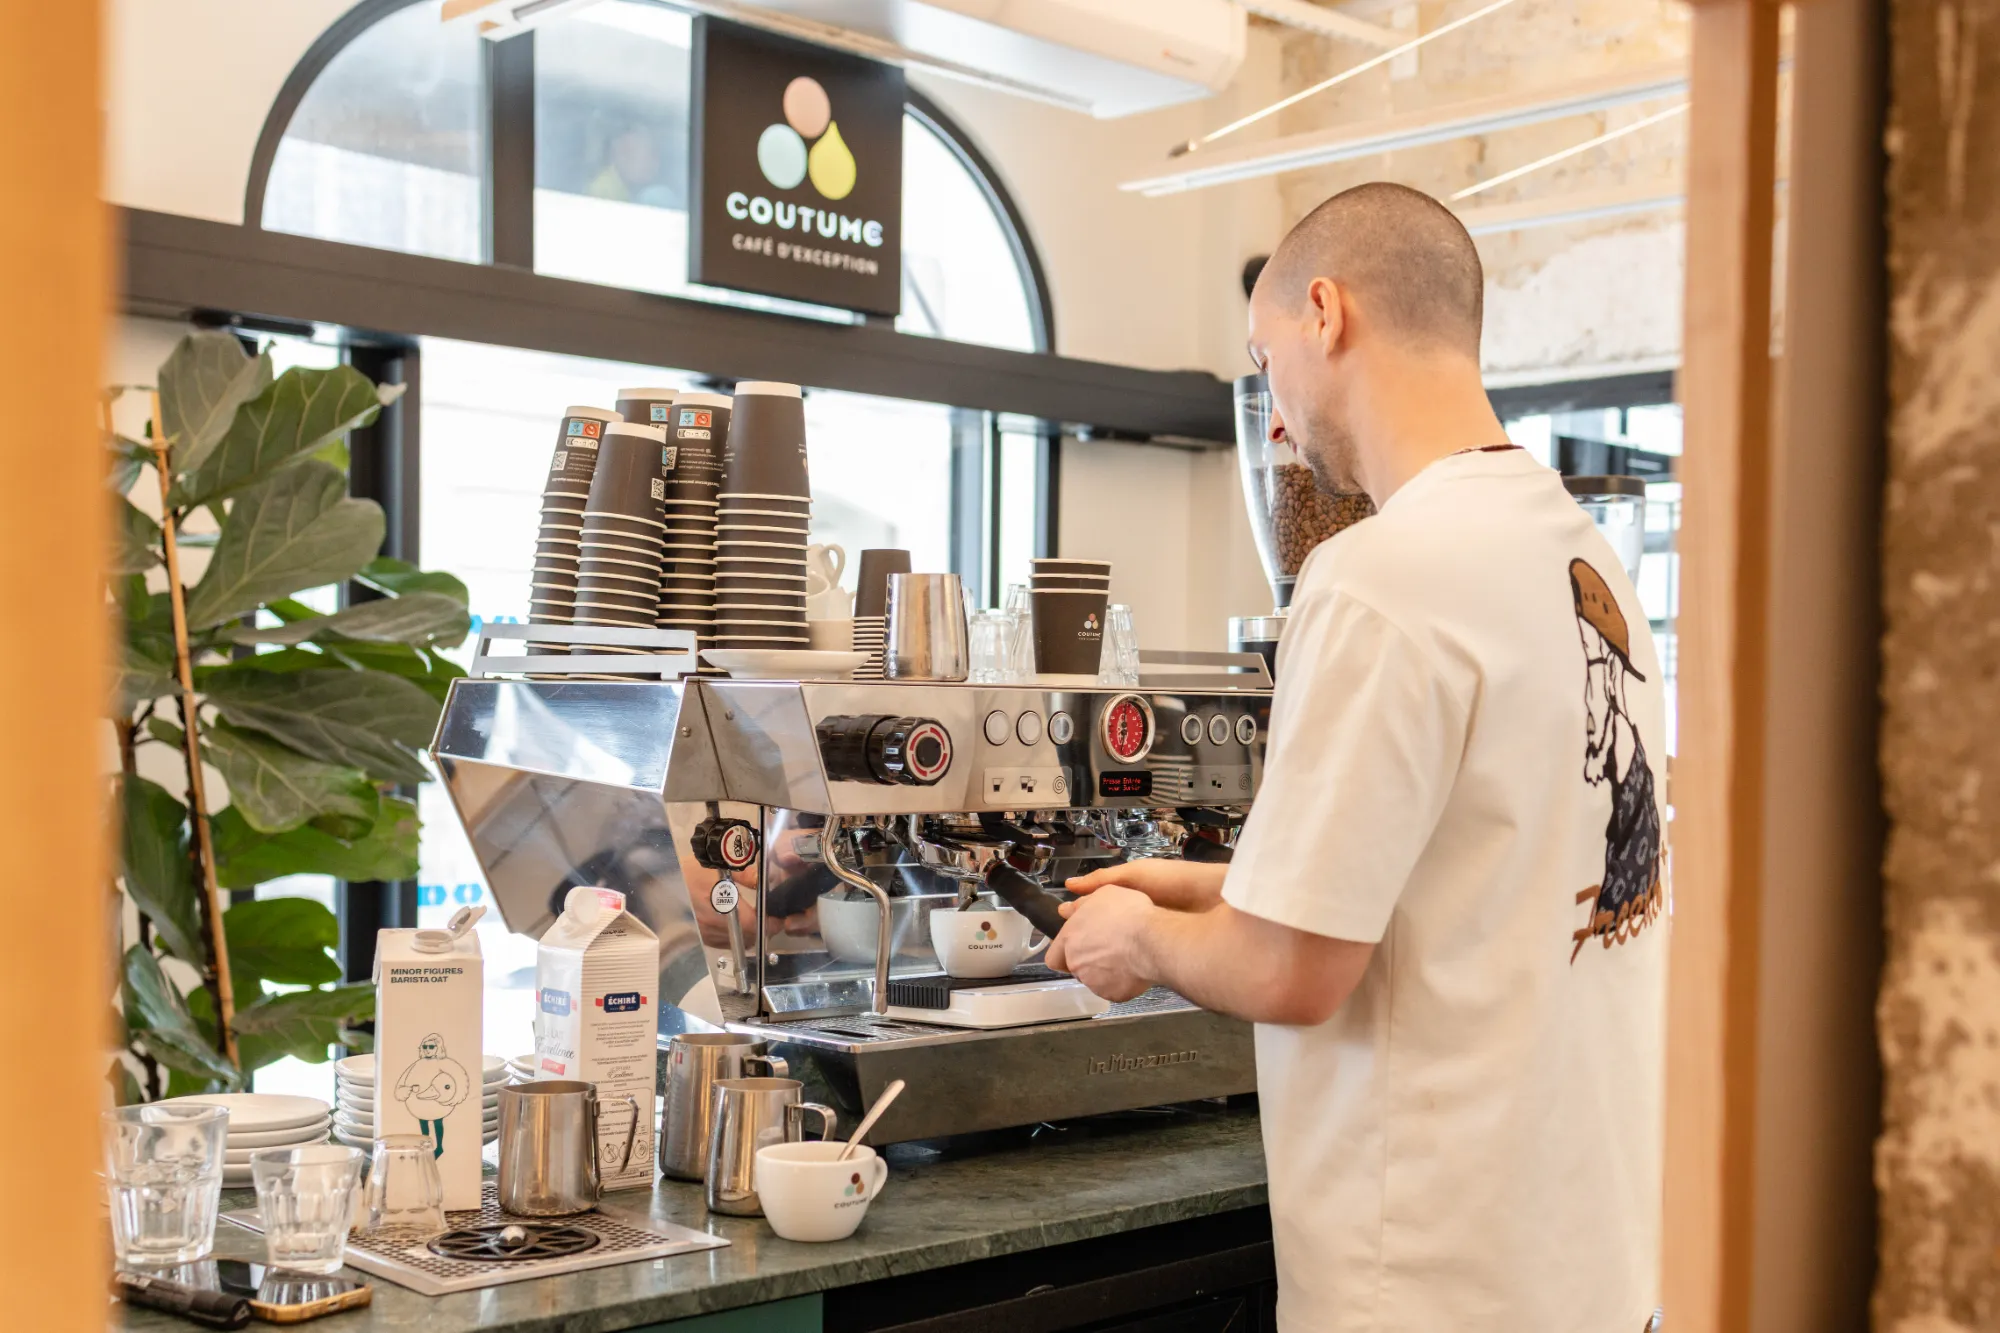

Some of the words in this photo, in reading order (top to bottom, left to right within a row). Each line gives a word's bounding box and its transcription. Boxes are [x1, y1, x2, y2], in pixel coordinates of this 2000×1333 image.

[726, 191, 884, 247] COUTUME
[732, 233, 774, 256] CAFÉ
[777, 242, 878, 275] D'EXCEPTION
[544, 992, 567, 1006] ÉCHIRÉ
[608, 995, 636, 1005] ÉCHIRÉ
